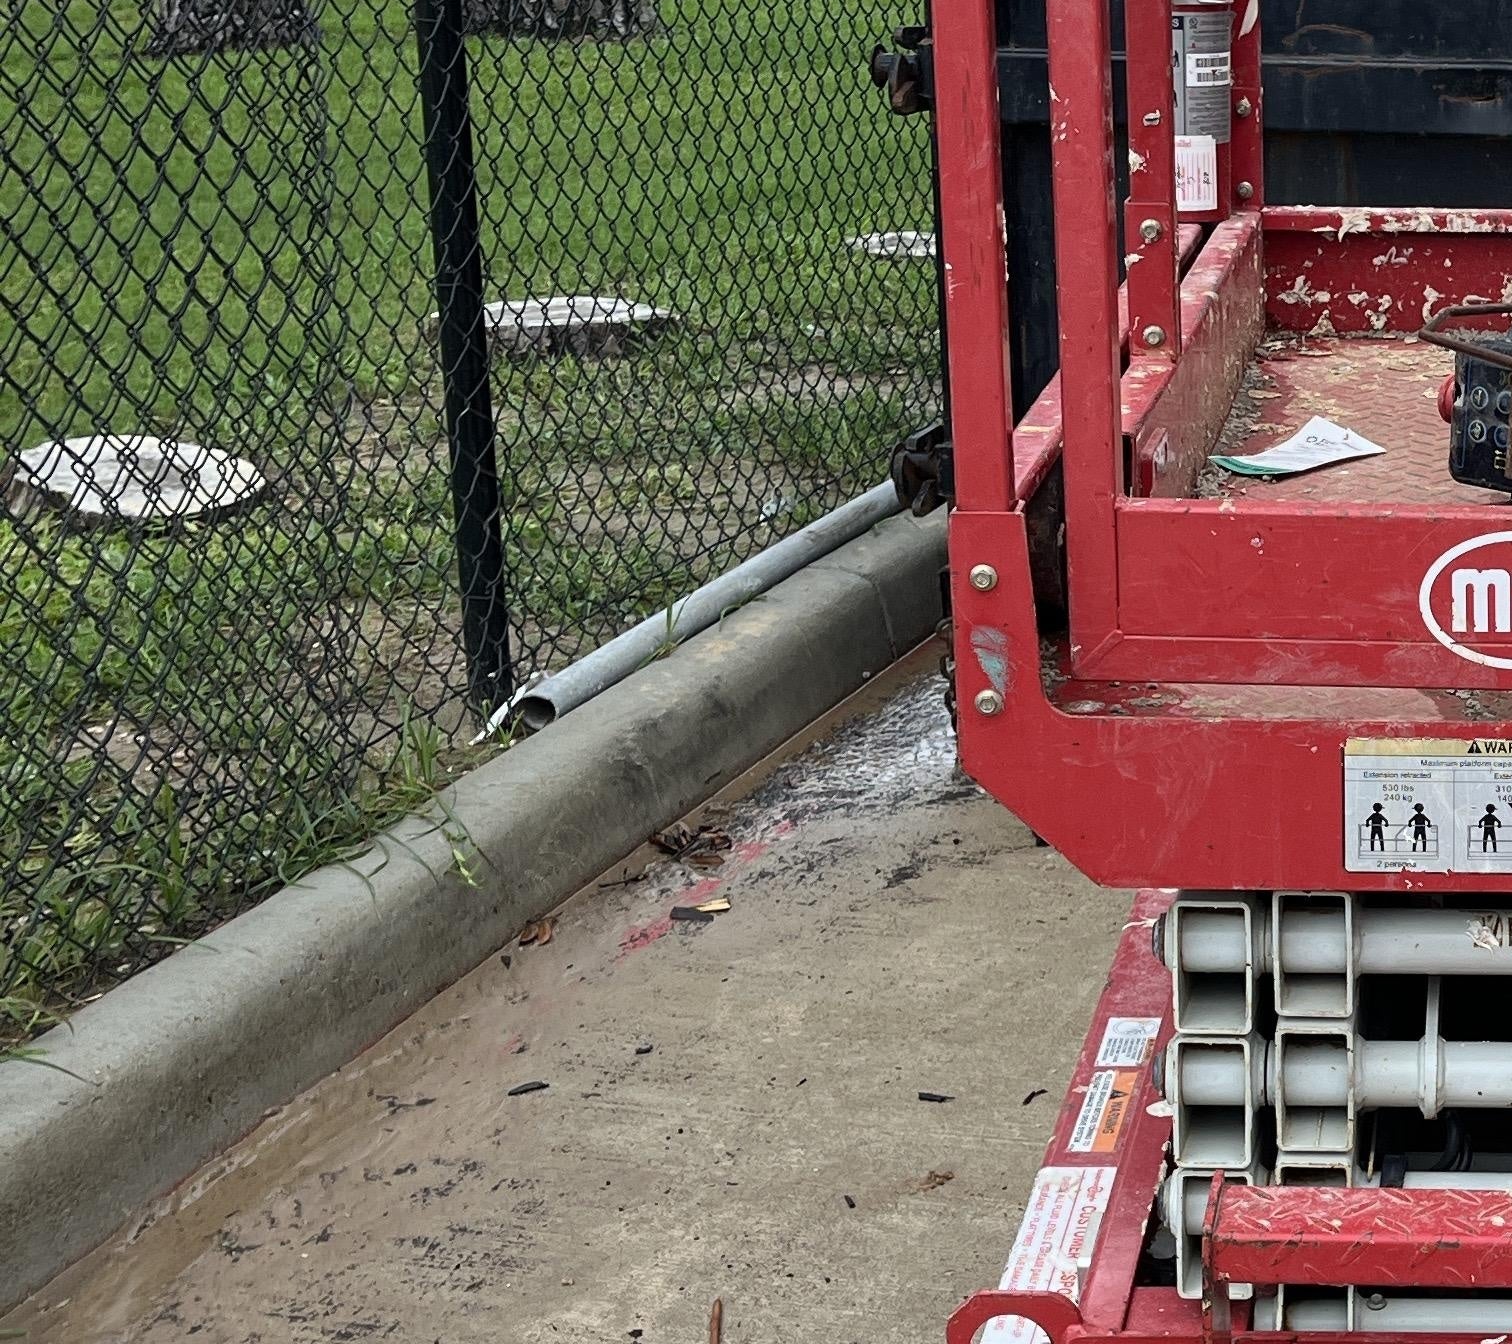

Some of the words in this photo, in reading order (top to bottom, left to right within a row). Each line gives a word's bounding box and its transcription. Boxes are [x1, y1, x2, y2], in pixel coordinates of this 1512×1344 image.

[1460, 760, 1492, 769] platform
[1363, 771, 1399, 779] Extension
[1382, 784, 1399, 792] 530
[1400, 784, 1415, 792] lbs
[1495, 785, 1512, 793] 310
[1383, 794, 1400, 802] 240
[1402, 793, 1413, 803] kg
[1498, 795, 1512, 803] 140
